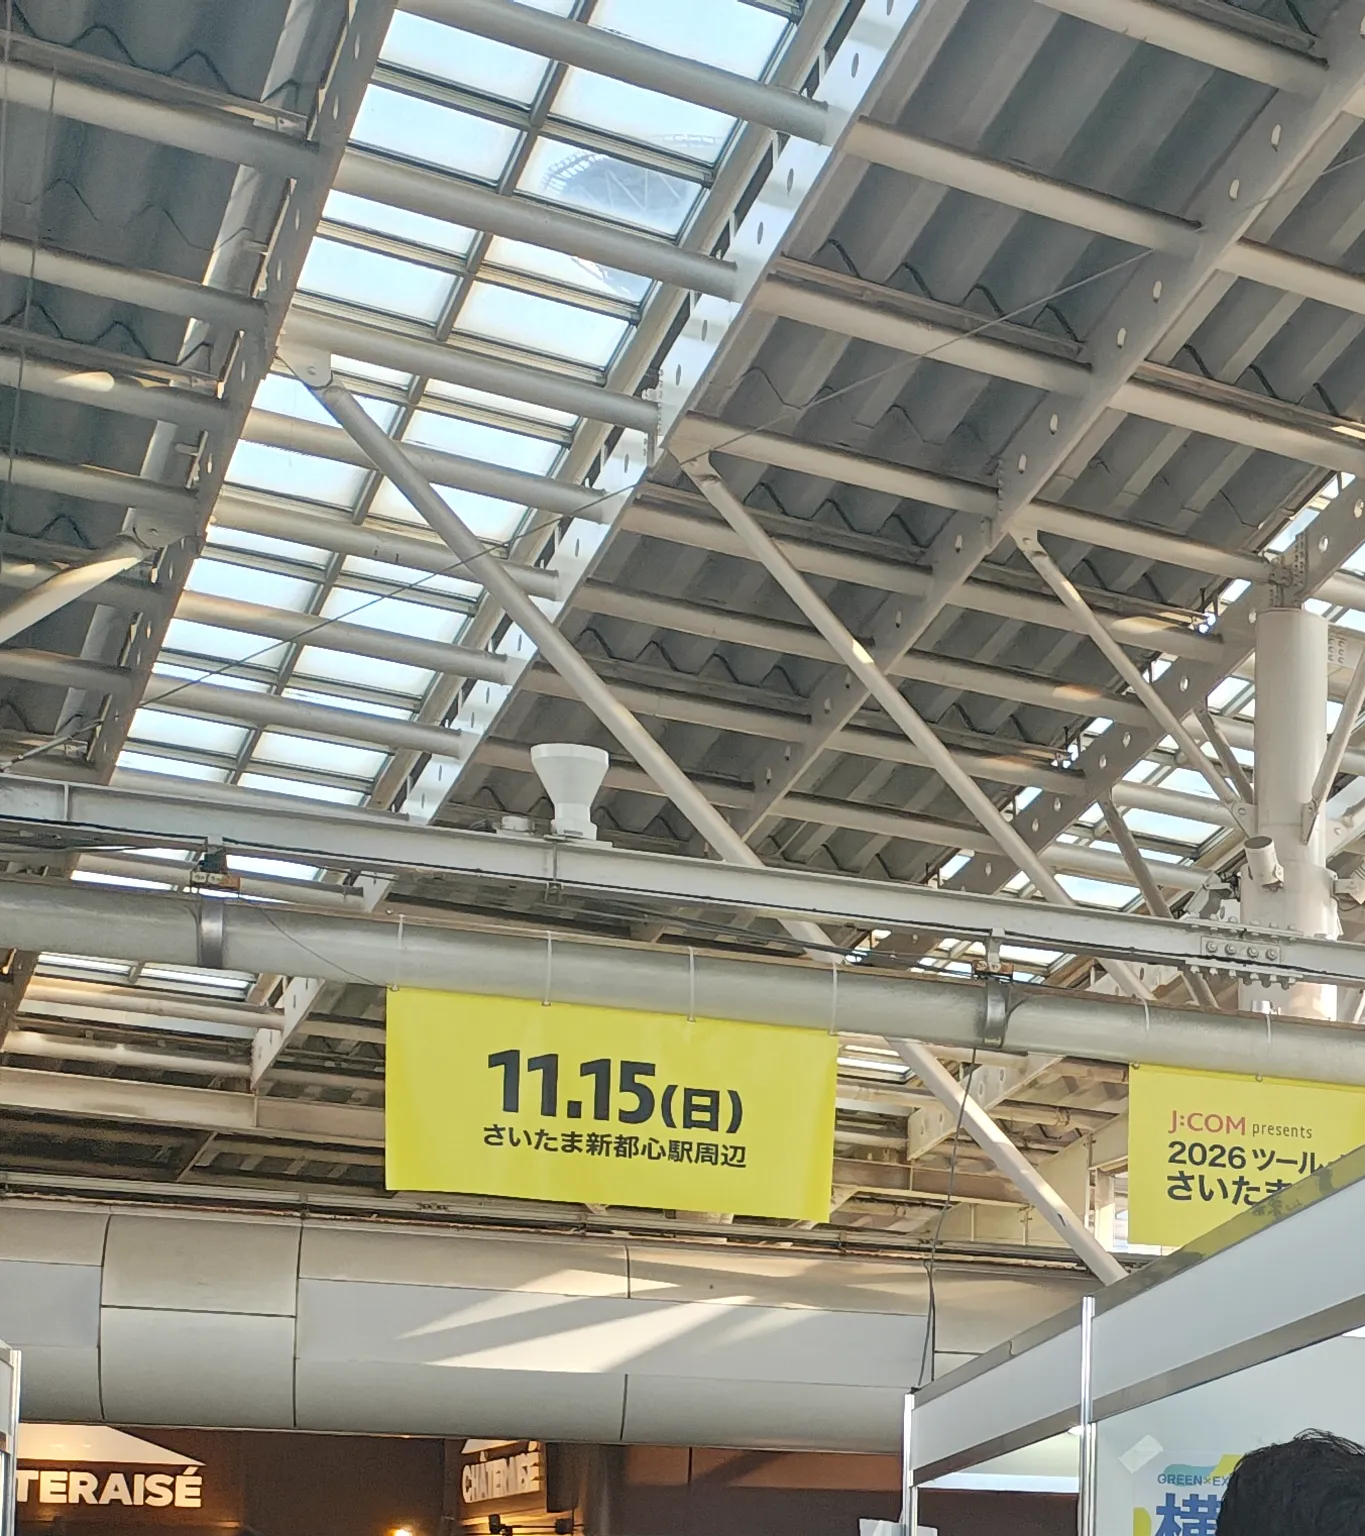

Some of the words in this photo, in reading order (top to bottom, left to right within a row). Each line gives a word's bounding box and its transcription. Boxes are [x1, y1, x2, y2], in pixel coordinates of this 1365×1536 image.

[487, 1049, 743, 1134] 11.15(日)
[1168, 1110, 1246, 1136] J:COM
[1252, 1121, 1313, 1139] presents
[483, 1124, 747, 1168] さいたま新都心駅周辺
[1168, 1141, 1246, 1169] 2026
